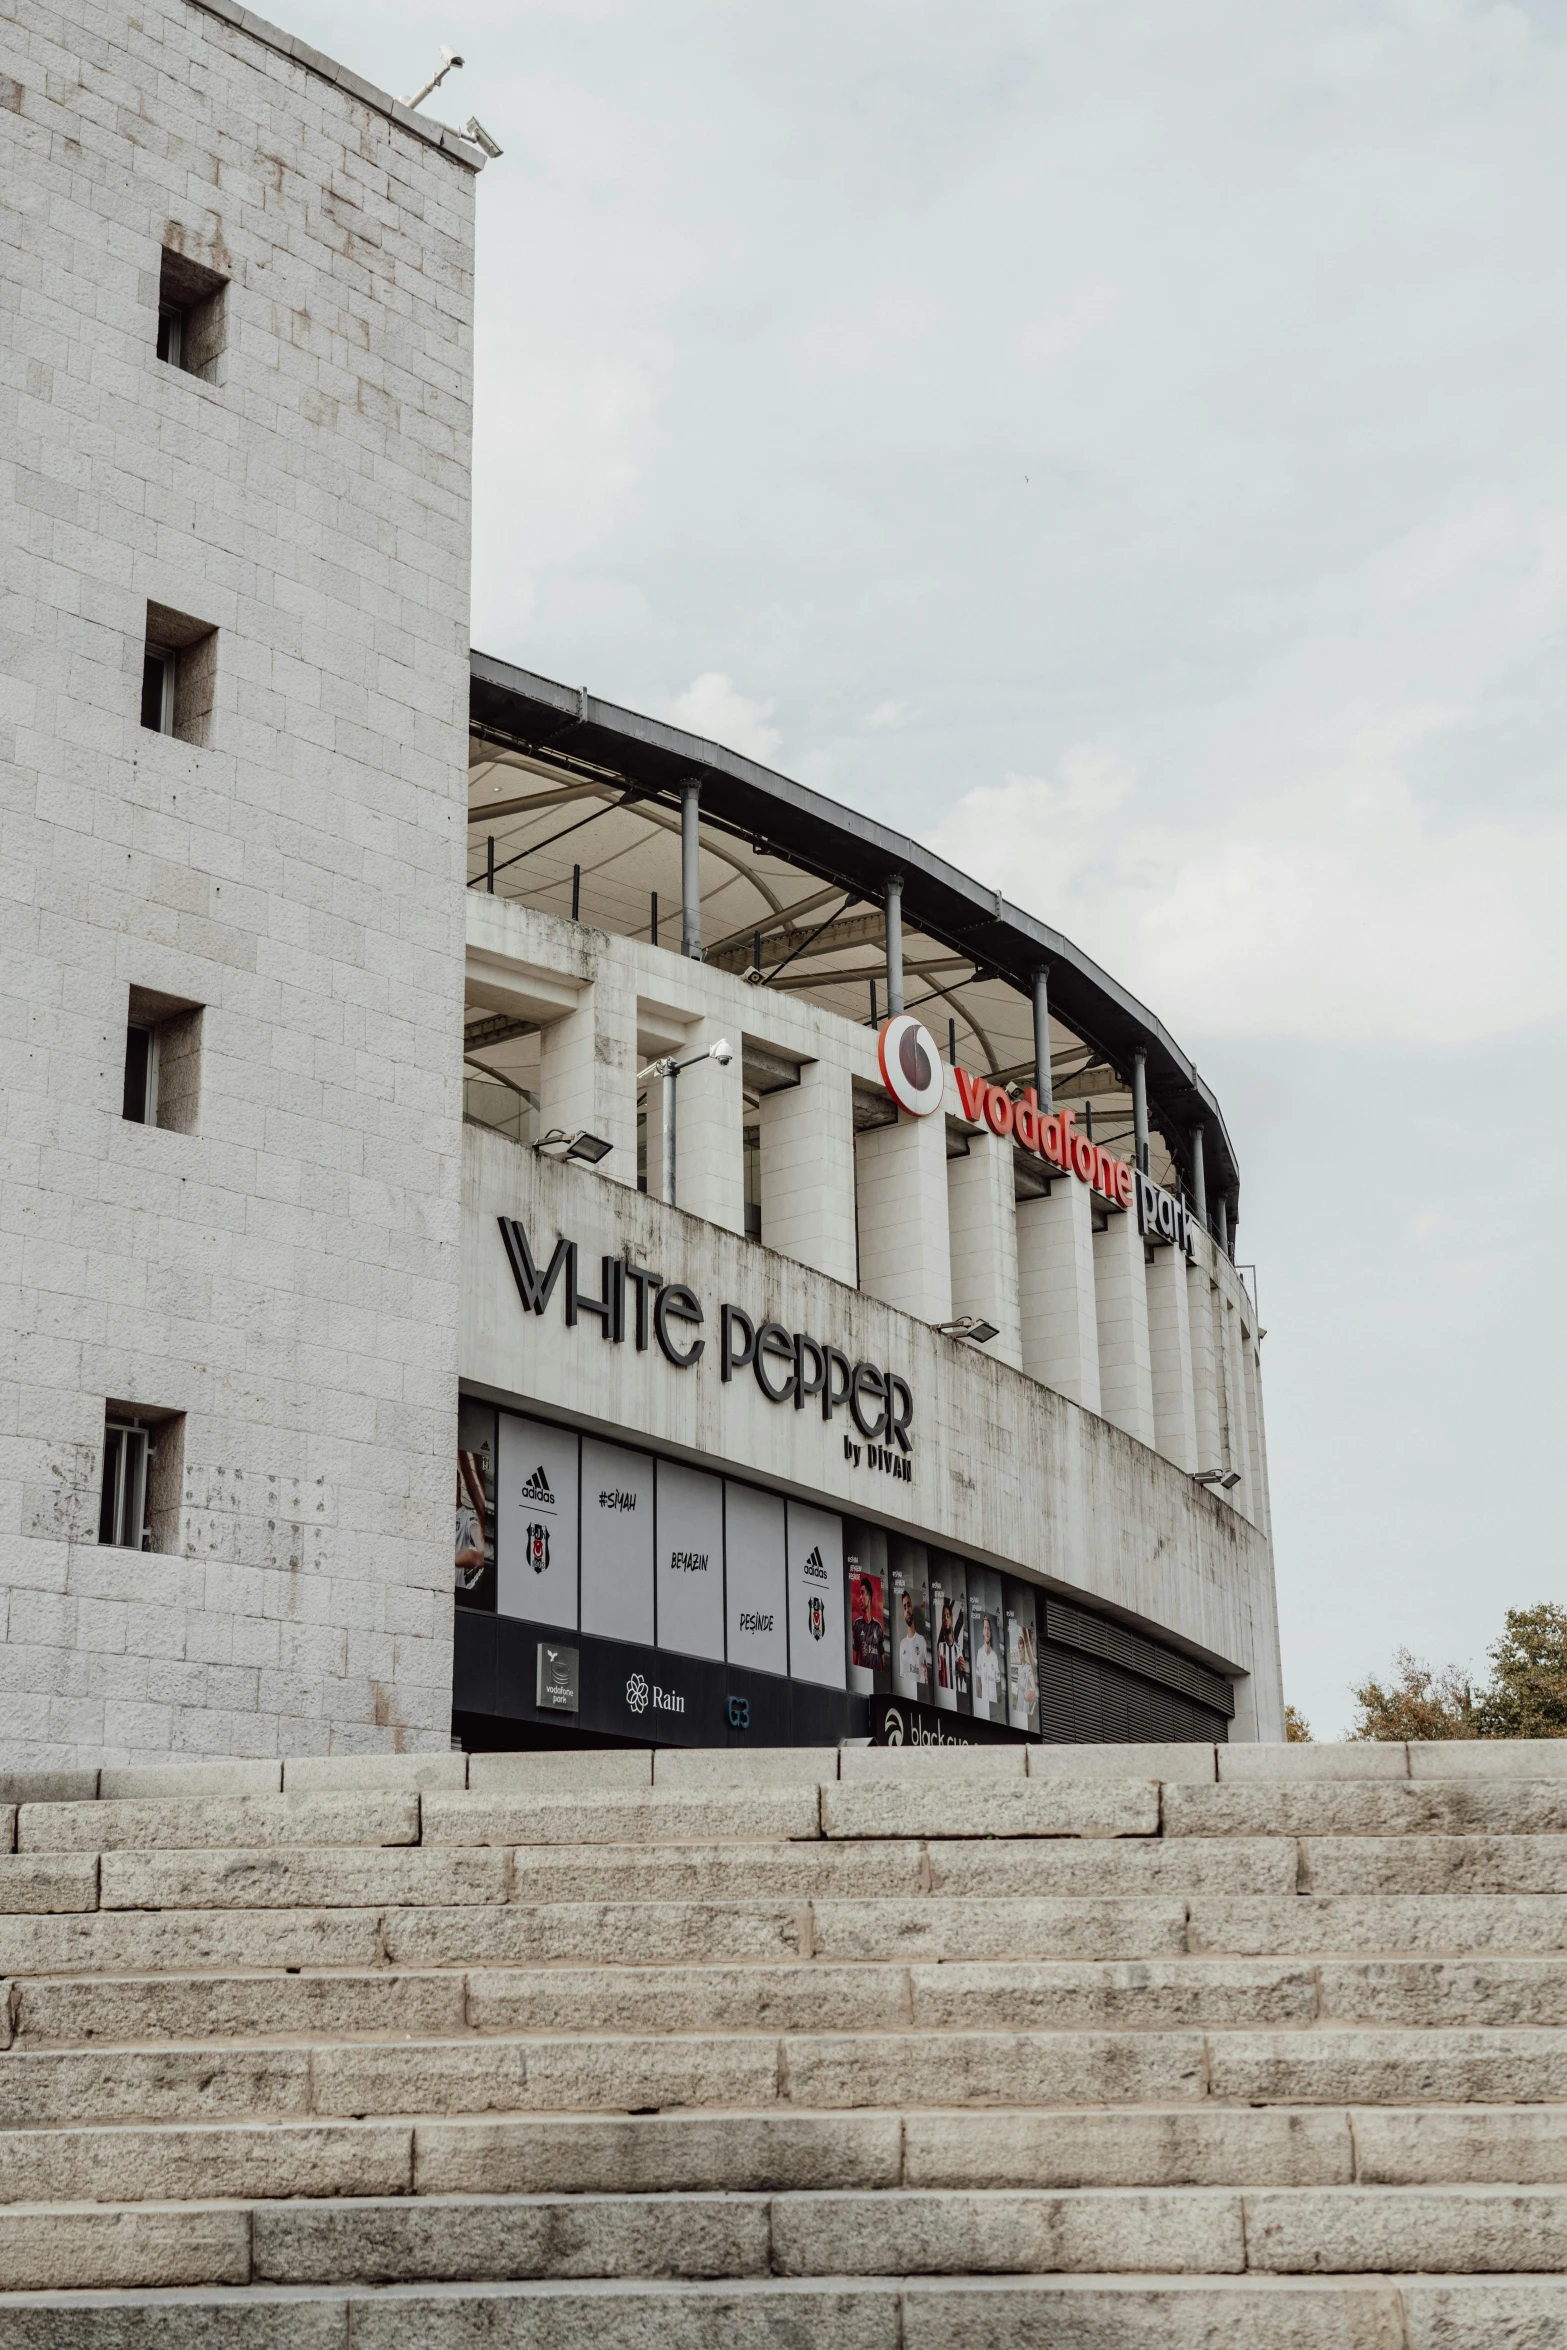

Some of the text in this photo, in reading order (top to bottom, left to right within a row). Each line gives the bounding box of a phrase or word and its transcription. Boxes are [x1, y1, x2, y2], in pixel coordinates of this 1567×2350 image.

[954, 1067, 1195, 1257] vodafone park
[843, 1434, 861, 1469] by
[521, 1486, 555, 1504] adidas
[670, 1551, 709, 1573] BEYAZIN
[803, 1563, 828, 1580] adidas
[546, 1685, 574, 1697] vodafone
[552, 1695, 567, 1705] park
[652, 1685, 685, 1713] Rain
[910, 1712, 945, 1747] black
